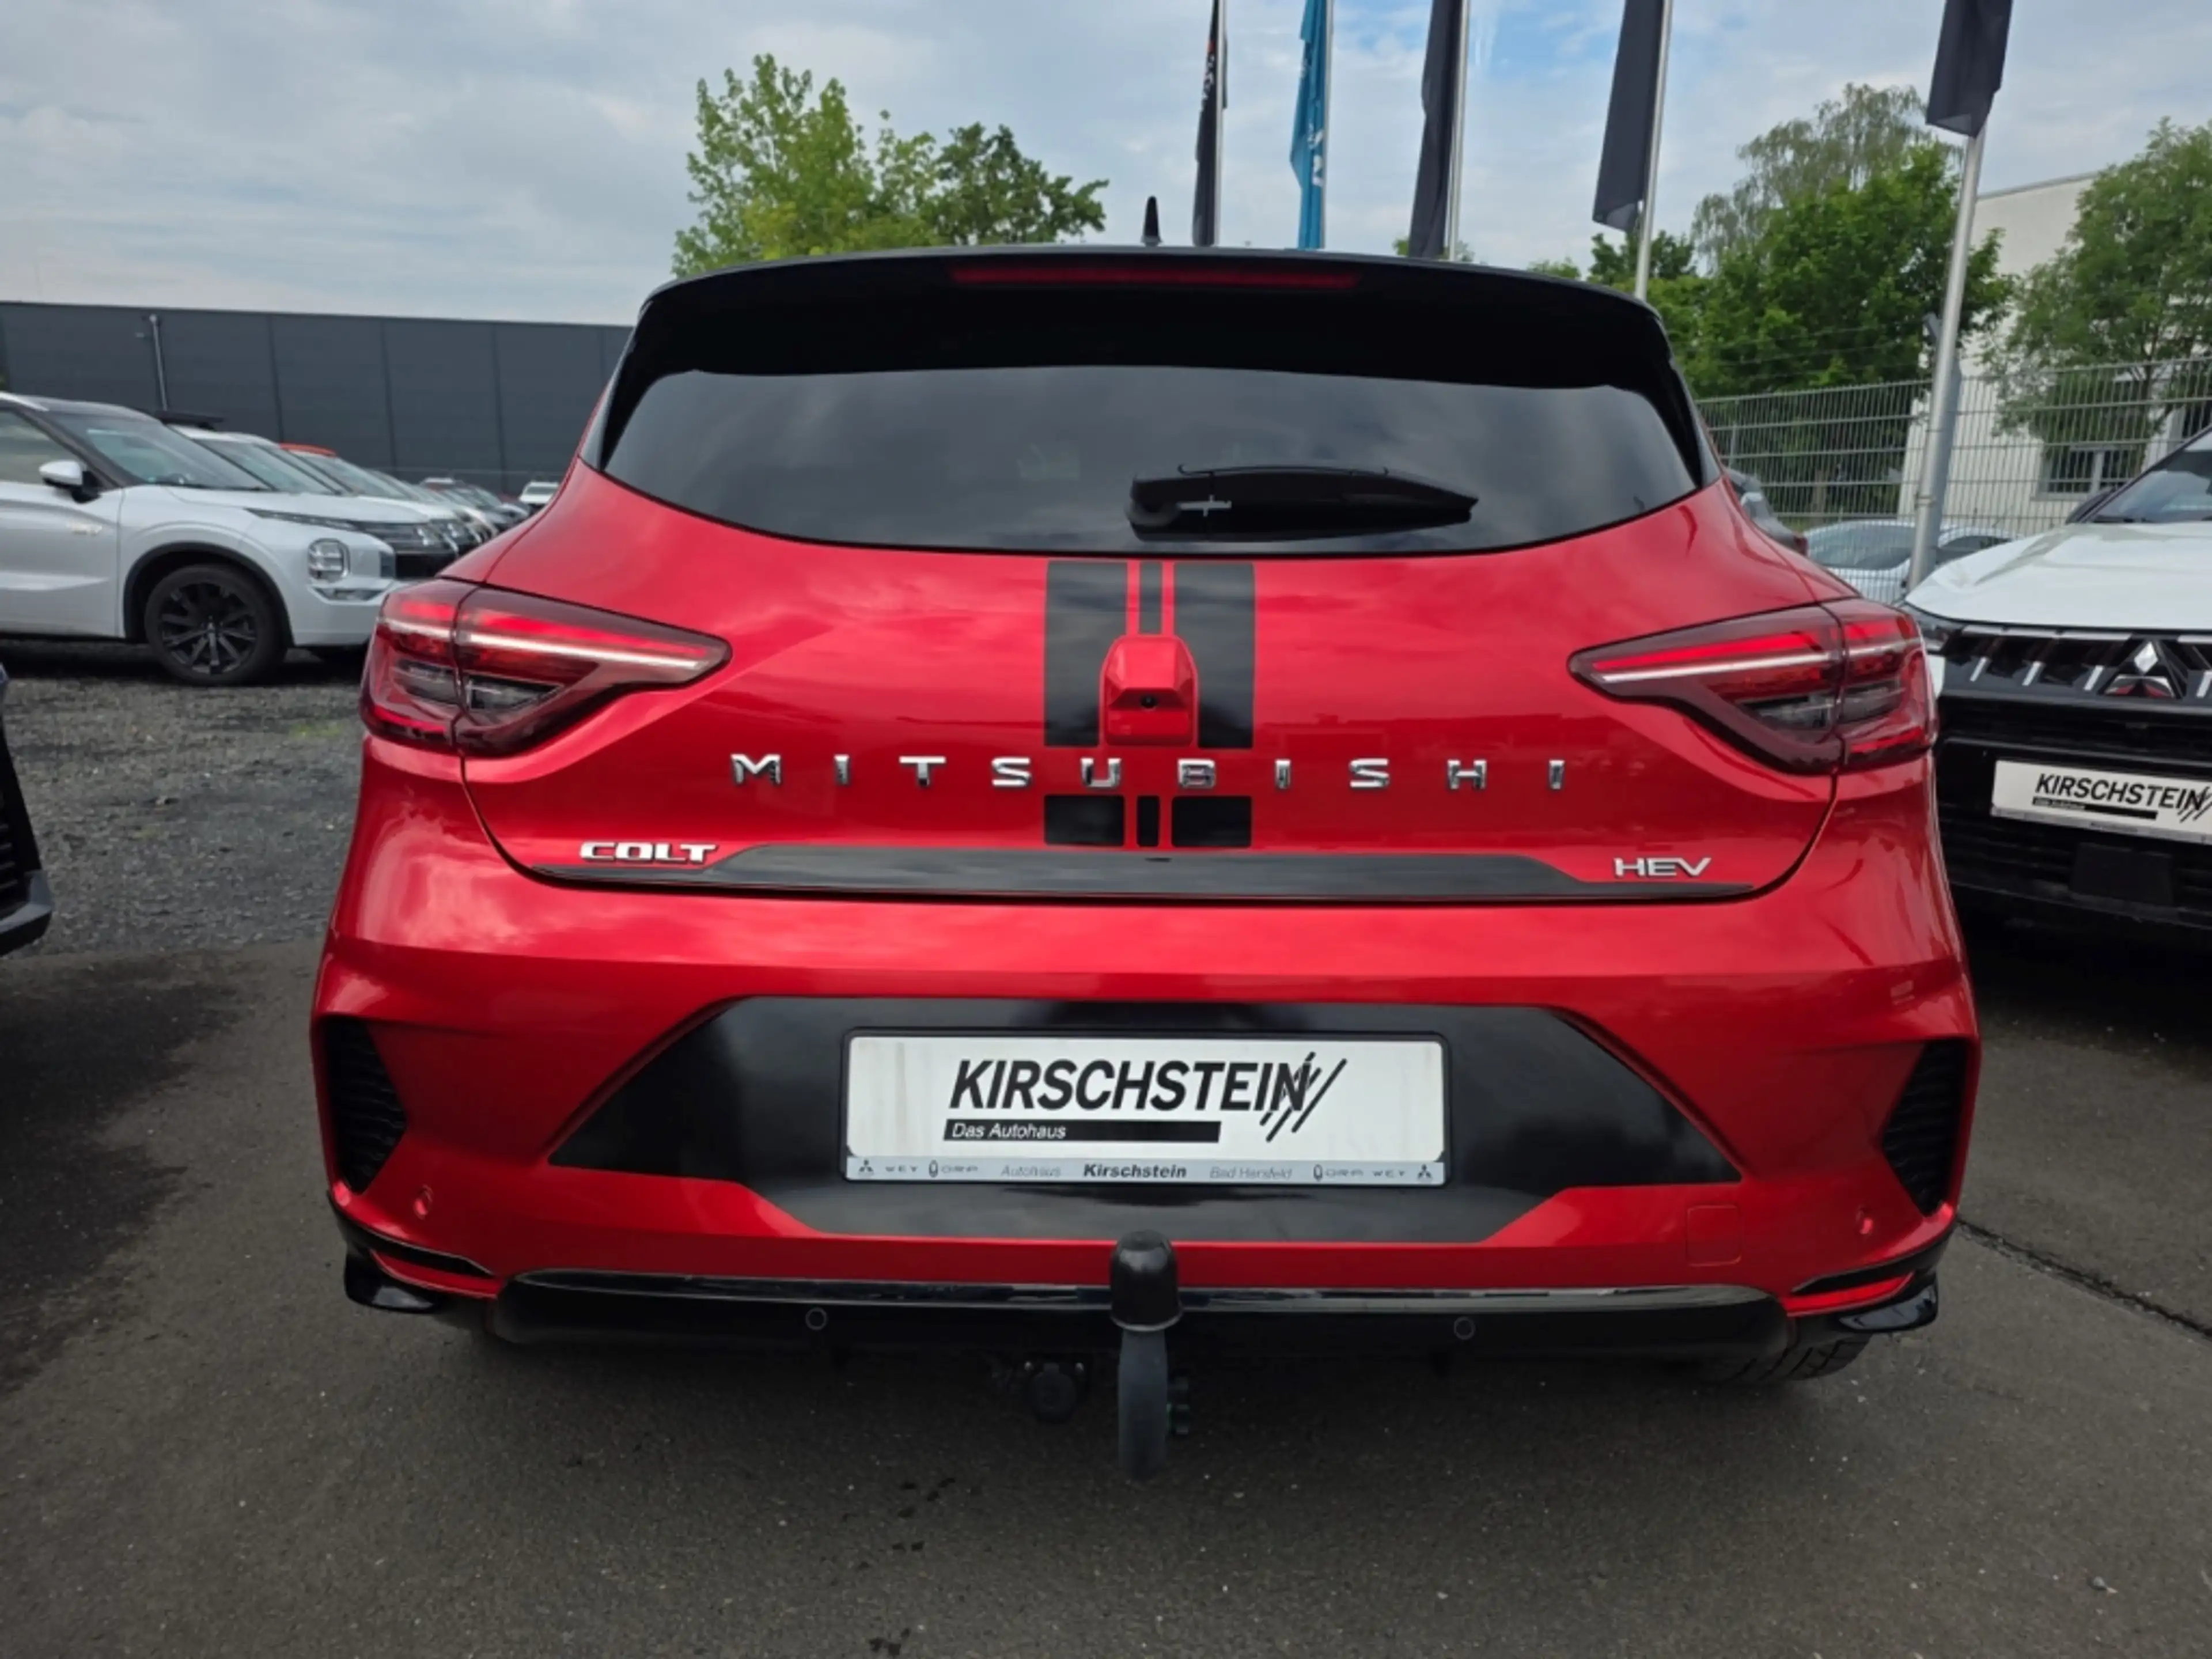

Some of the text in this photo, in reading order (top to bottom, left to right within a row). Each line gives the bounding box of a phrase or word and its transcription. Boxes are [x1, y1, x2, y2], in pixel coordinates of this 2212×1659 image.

[732, 753, 1566, 790] MITSUBISHI
[2035, 773, 2206, 810] KIRSCHSTEIN
[579, 841, 718, 863] COLT
[1613, 857, 1713, 877] HEV
[949, 1059, 1312, 1111] KIRSCHSTEIN
[952, 1122, 1067, 1139] Das Autohaus
[1000, 1164, 1062, 1177] Autohaus
[1083, 1163, 1187, 1178] Kirschstein
[1210, 1166, 1236, 1179] Bad
